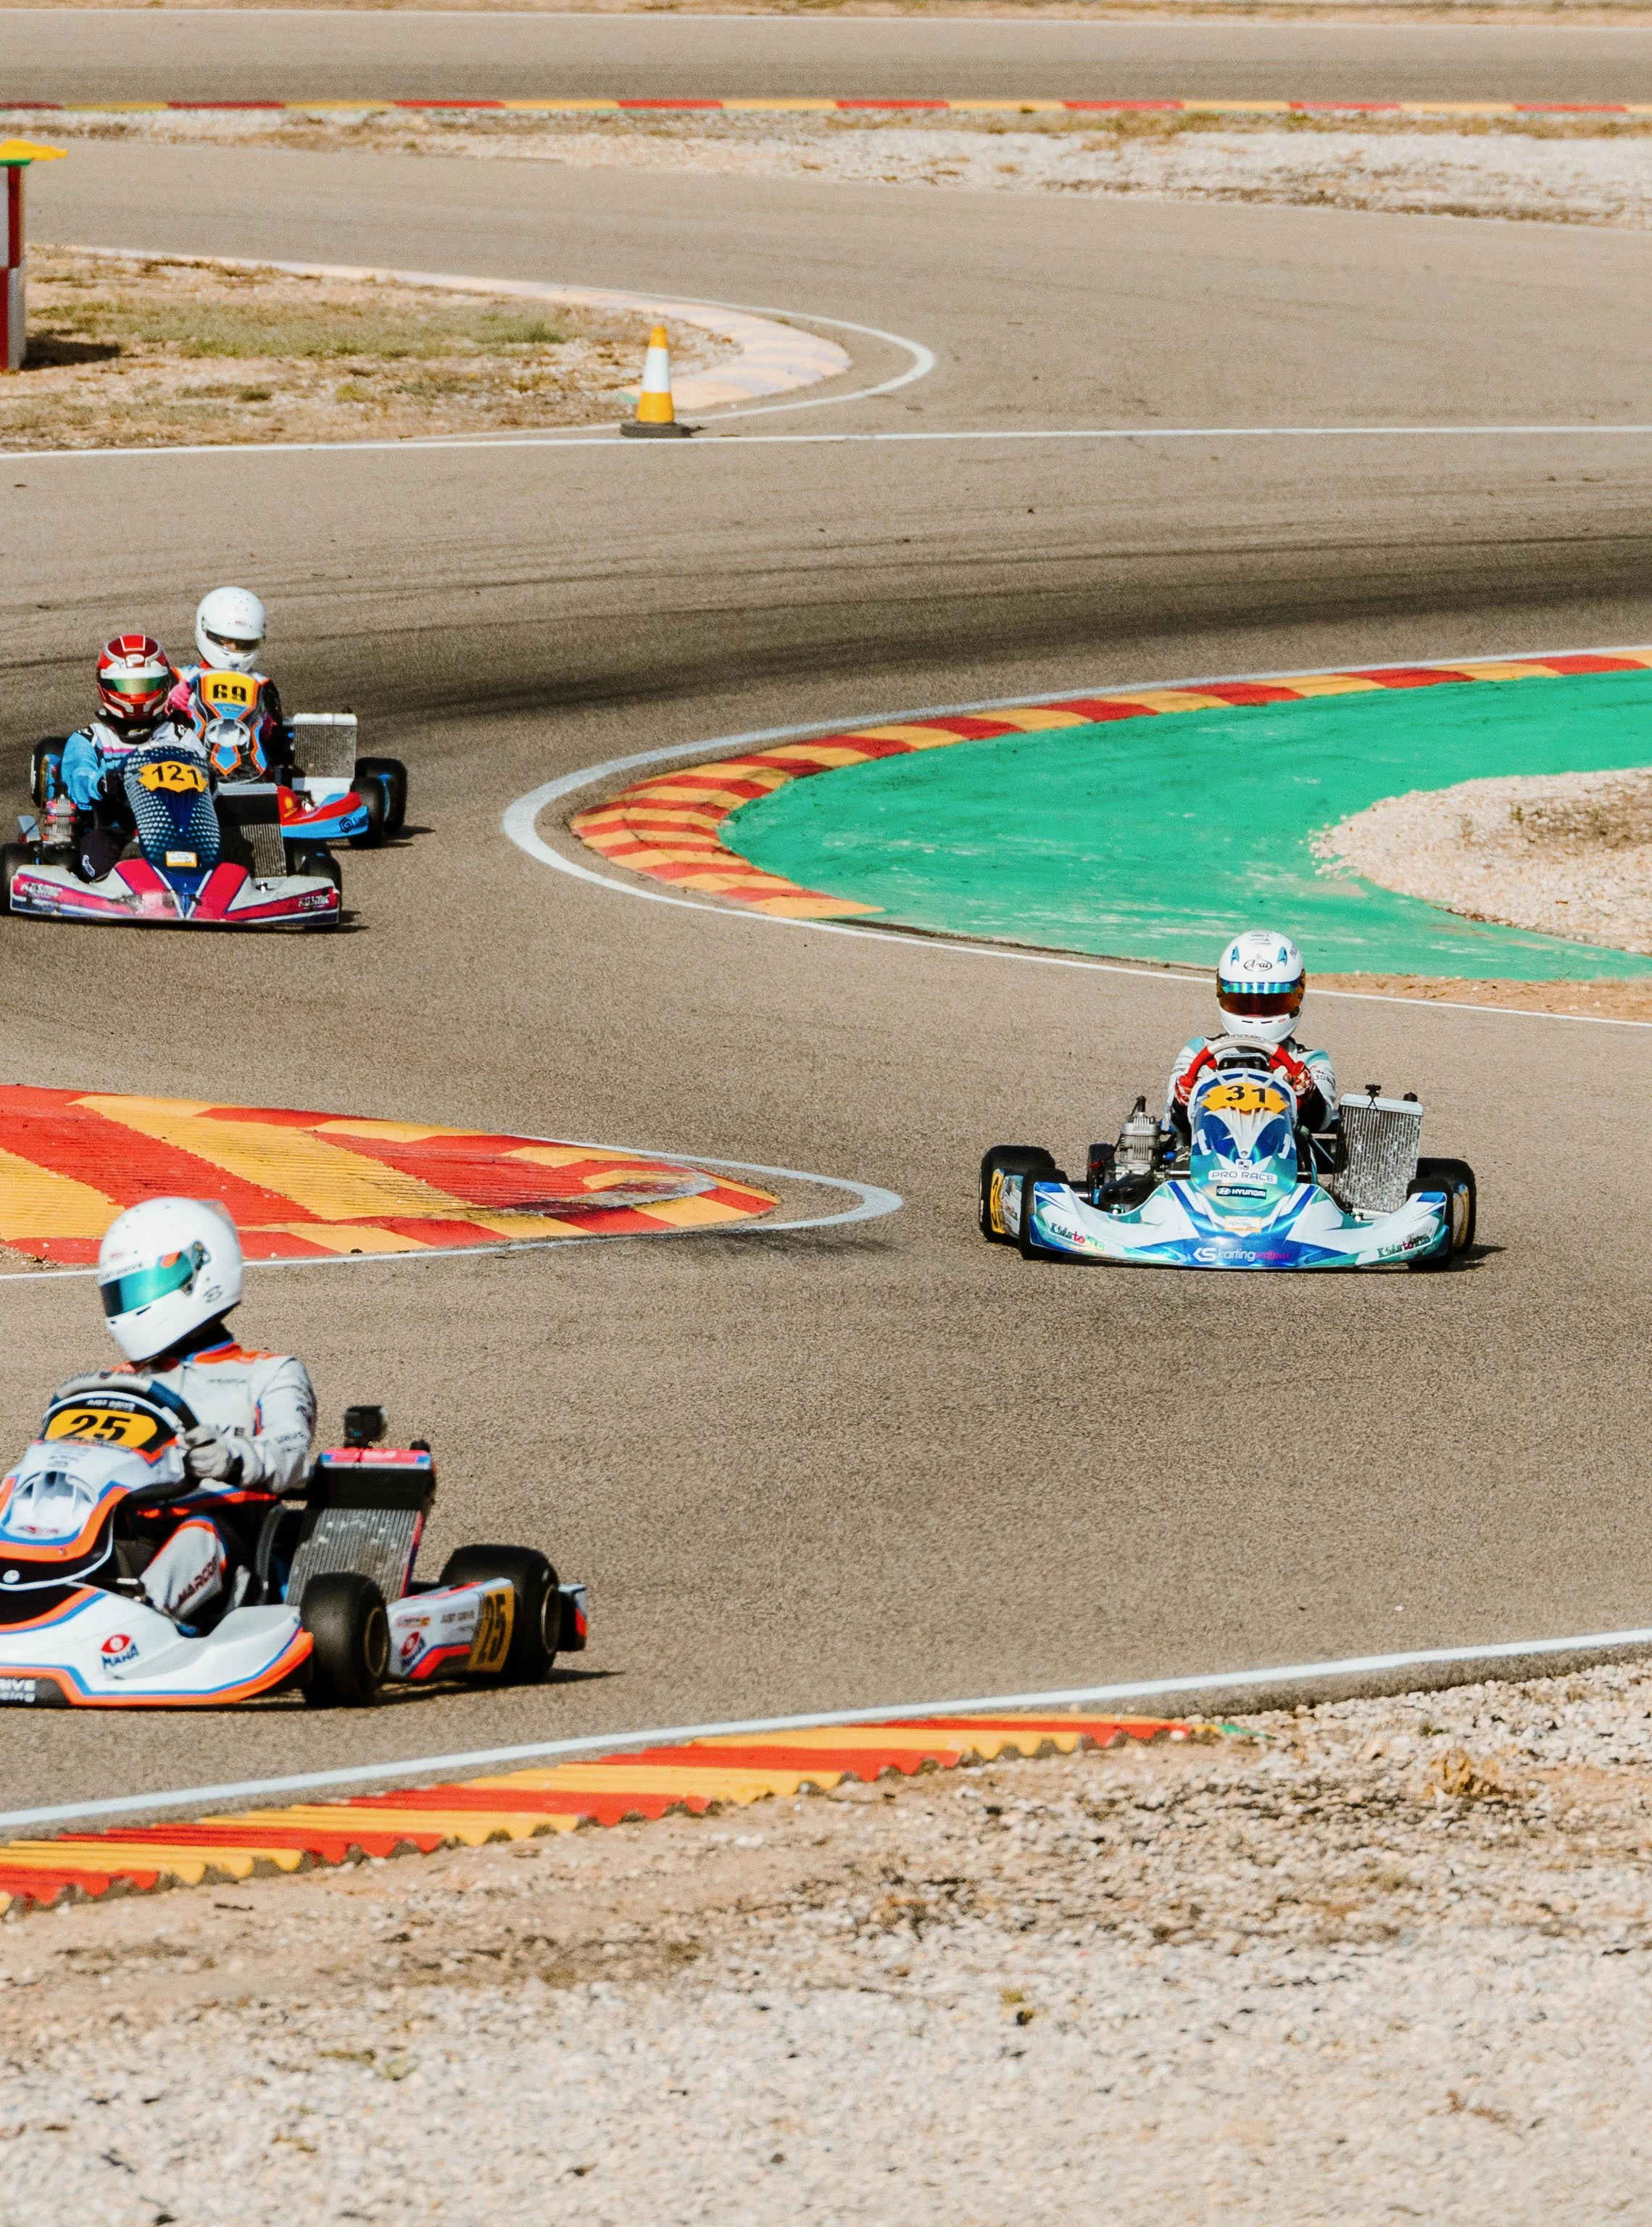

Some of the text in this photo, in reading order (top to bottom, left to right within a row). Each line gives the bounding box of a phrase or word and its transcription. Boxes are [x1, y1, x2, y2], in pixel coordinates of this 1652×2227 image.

[212, 684, 246, 702] 69
[151, 764, 199, 787] 121
[1245, 959, 1270, 969] Arai
[1226, 1085, 1266, 1104] 31
[1241, 1171, 1274, 1182] RACE
[1232, 1188, 1266, 1198] HYUNDAI
[58, 1414, 131, 1441] 25
[476, 1593, 508, 1663] 25
